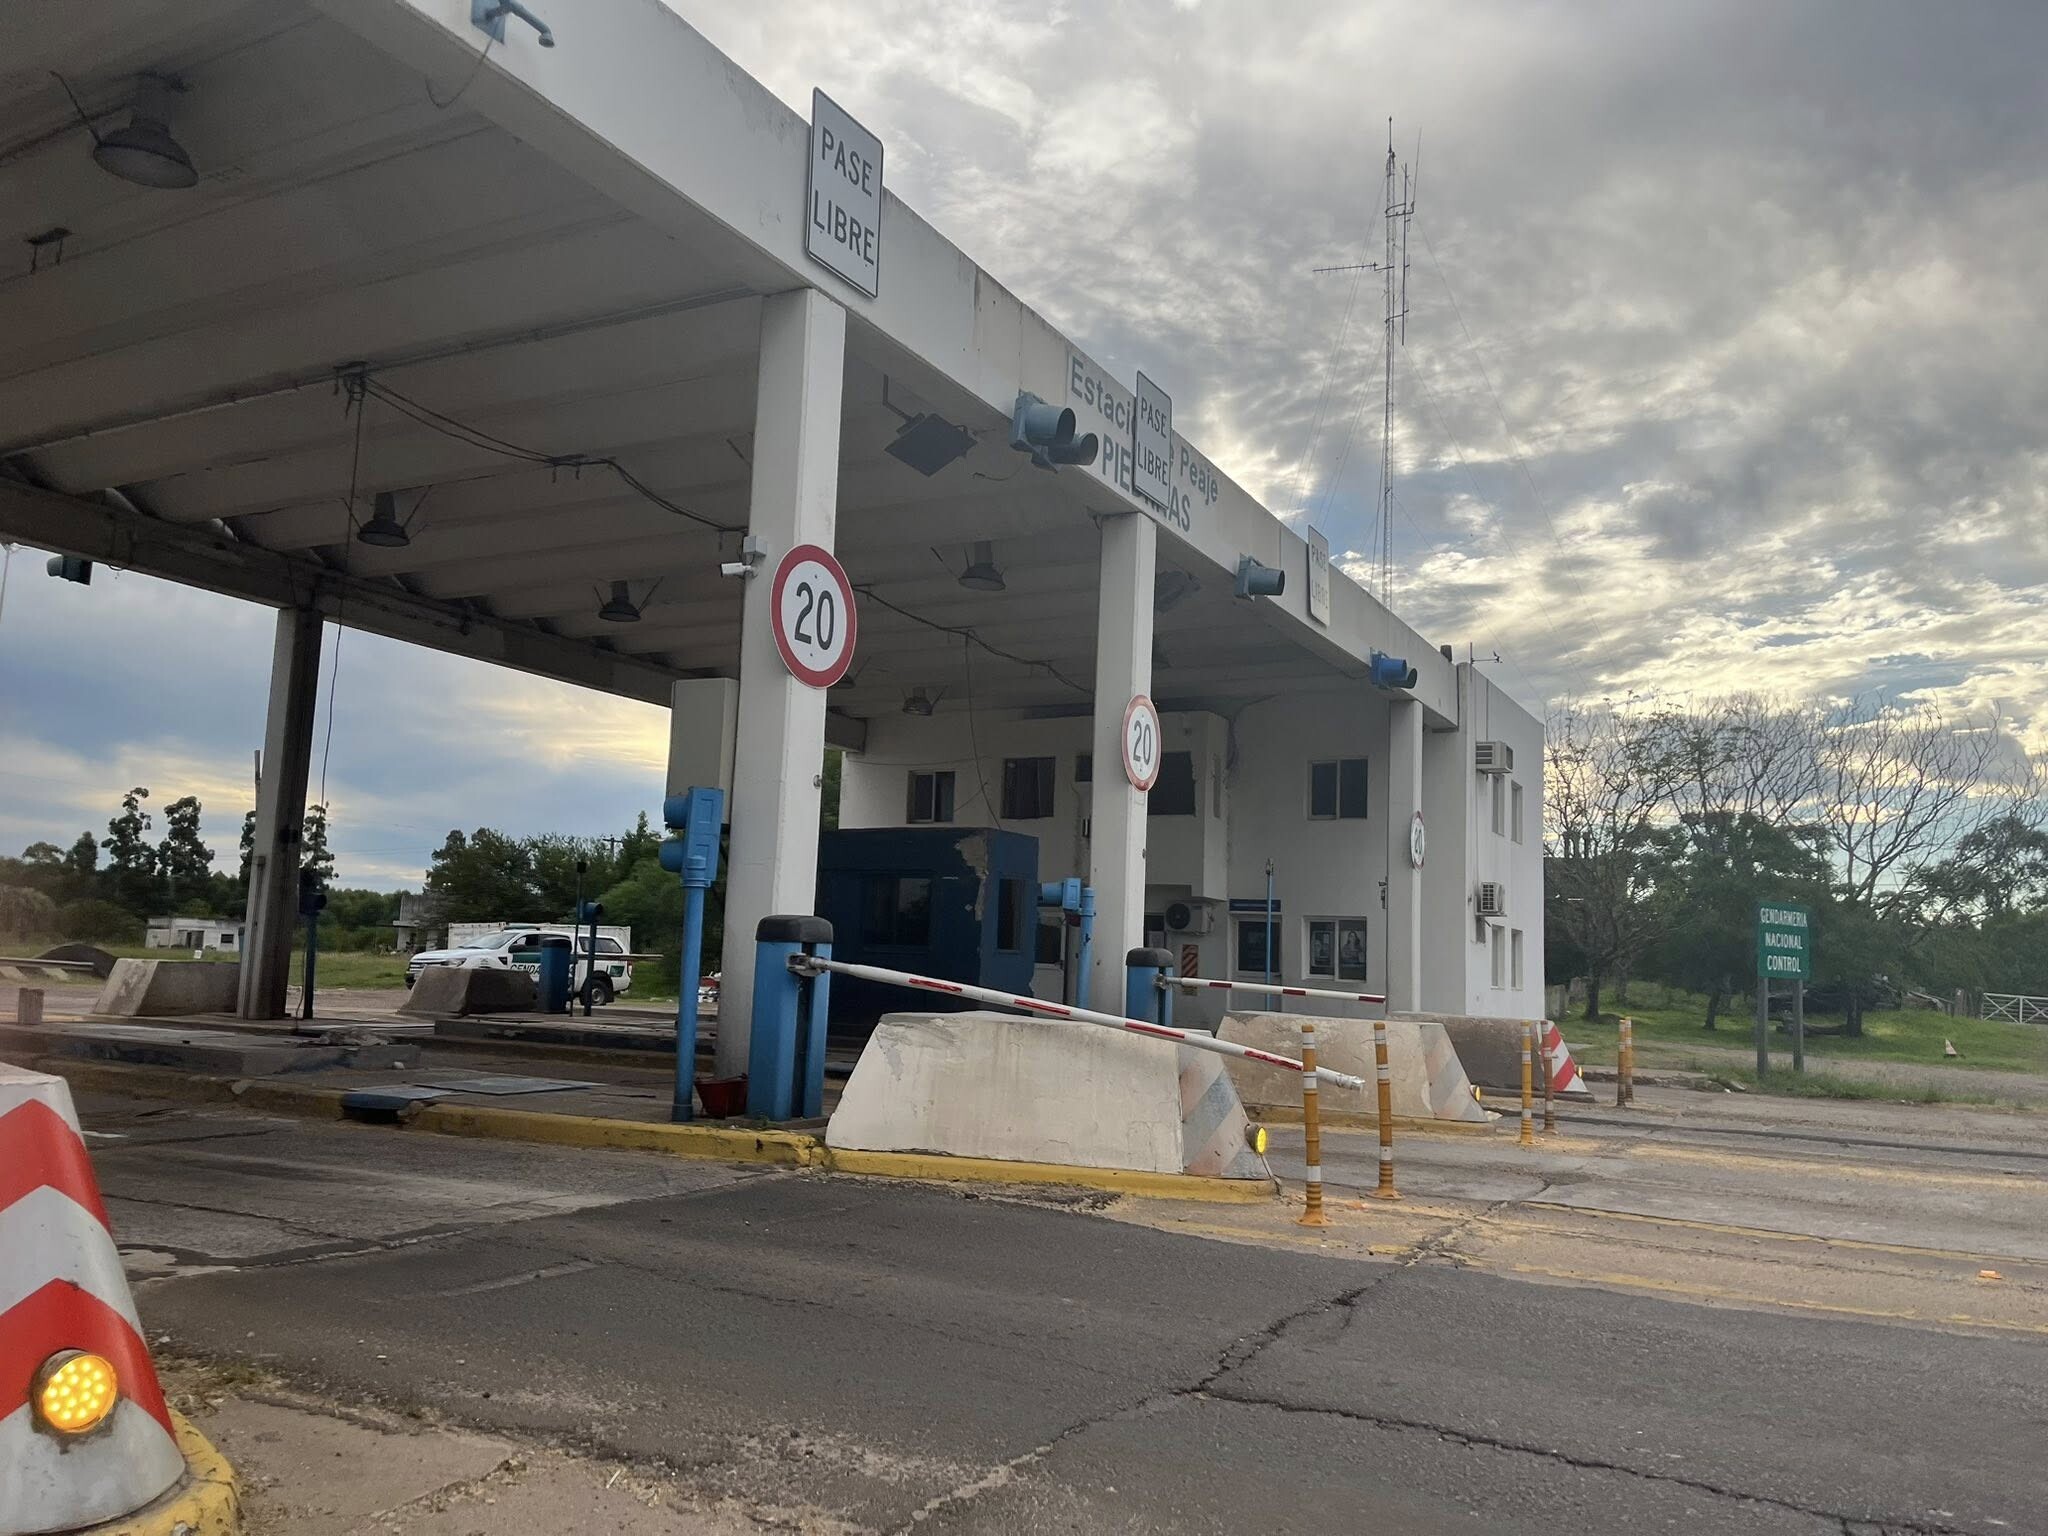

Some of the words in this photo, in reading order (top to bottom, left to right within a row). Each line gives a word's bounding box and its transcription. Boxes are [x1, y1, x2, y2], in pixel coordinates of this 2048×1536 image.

[822, 126, 873, 197] PASE
[813, 189, 875, 266] LIBRE
[1071, 356, 1136, 438] Estaci
[1180, 446, 1218, 506] Peaje
[1140, 397, 1167, 439] PASE
[1137, 441, 1168, 487] LIBRE
[794, 581, 834, 650] 20
[1133, 720, 1151, 765] 20
[1414, 827, 1423, 854] 20
[1765, 932, 1803, 949] NACIONAL
[1767, 955, 1801, 972] CONTROL
